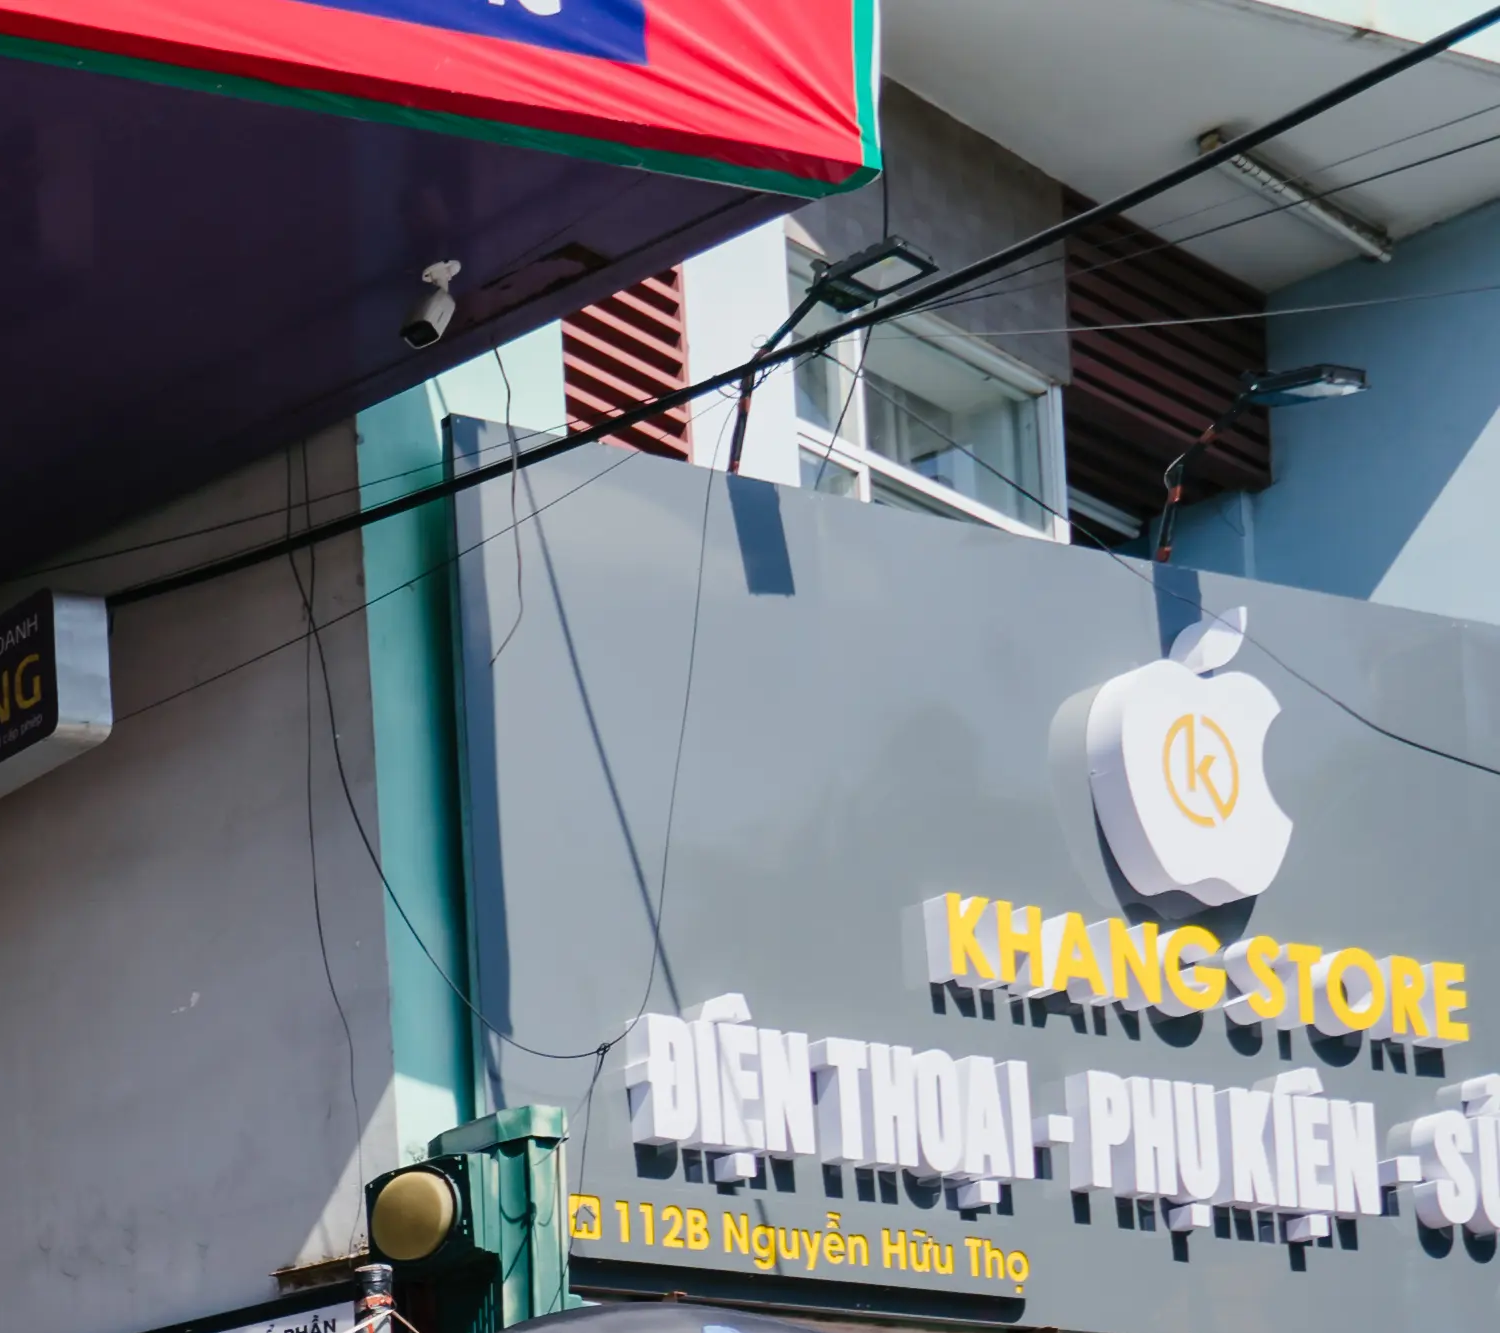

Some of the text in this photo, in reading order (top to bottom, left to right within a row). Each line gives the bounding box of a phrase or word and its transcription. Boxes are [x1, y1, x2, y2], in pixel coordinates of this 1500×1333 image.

[940, 892, 1469, 1042] KHANG STORE
[633, 993, 816, 1180] ĐIỆN
[818, 1038, 1035, 1209] THOẠI
[1076, 1070, 1221, 1231] PHỤ
[1222, 1067, 1383, 1242] KIỆN
[615, 1200, 1030, 1294] 112B Nguyễn Hữu Thọ
